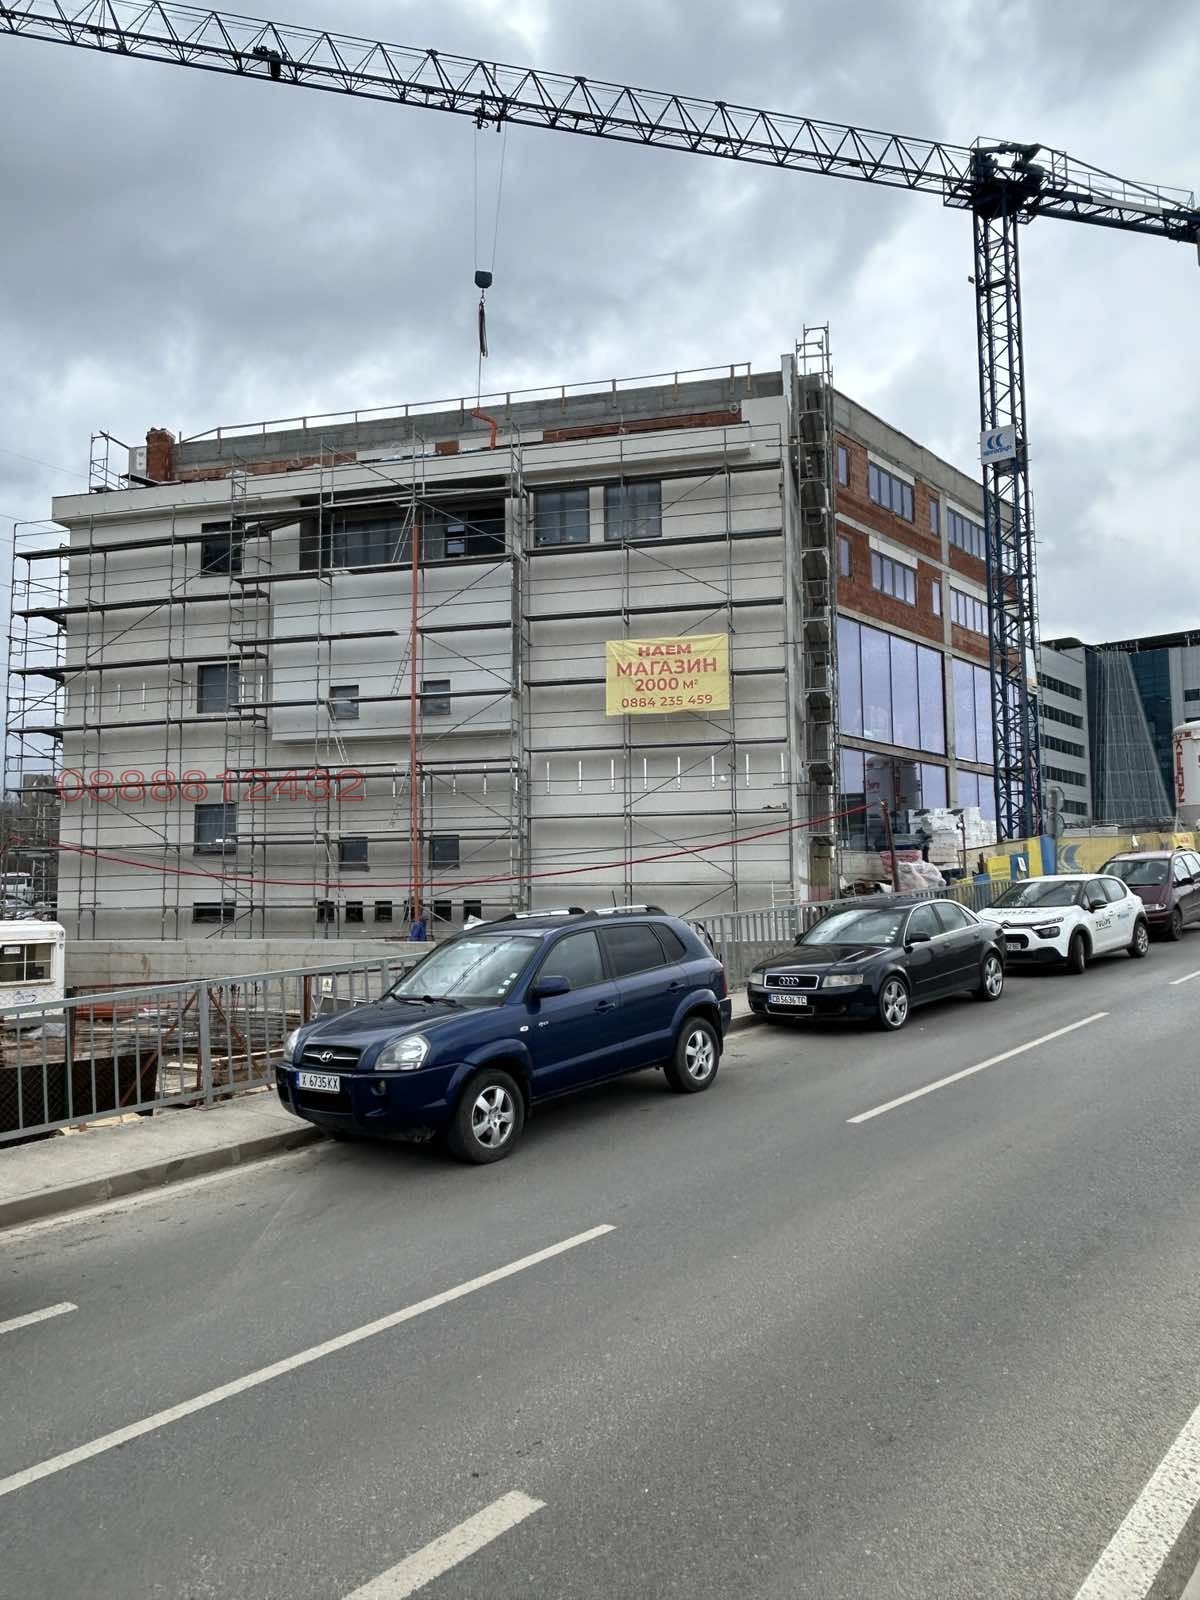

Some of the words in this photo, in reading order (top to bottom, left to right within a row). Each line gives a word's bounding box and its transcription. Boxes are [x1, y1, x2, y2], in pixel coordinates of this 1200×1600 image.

[637, 643, 692, 657] НАЕМ
[616, 657, 717, 677] МАГАЗИН
[635, 678, 679, 692] 2000
[621, 697, 656, 709] 0884
[660, 695, 683, 707] 235
[687, 694, 713, 705] 459
